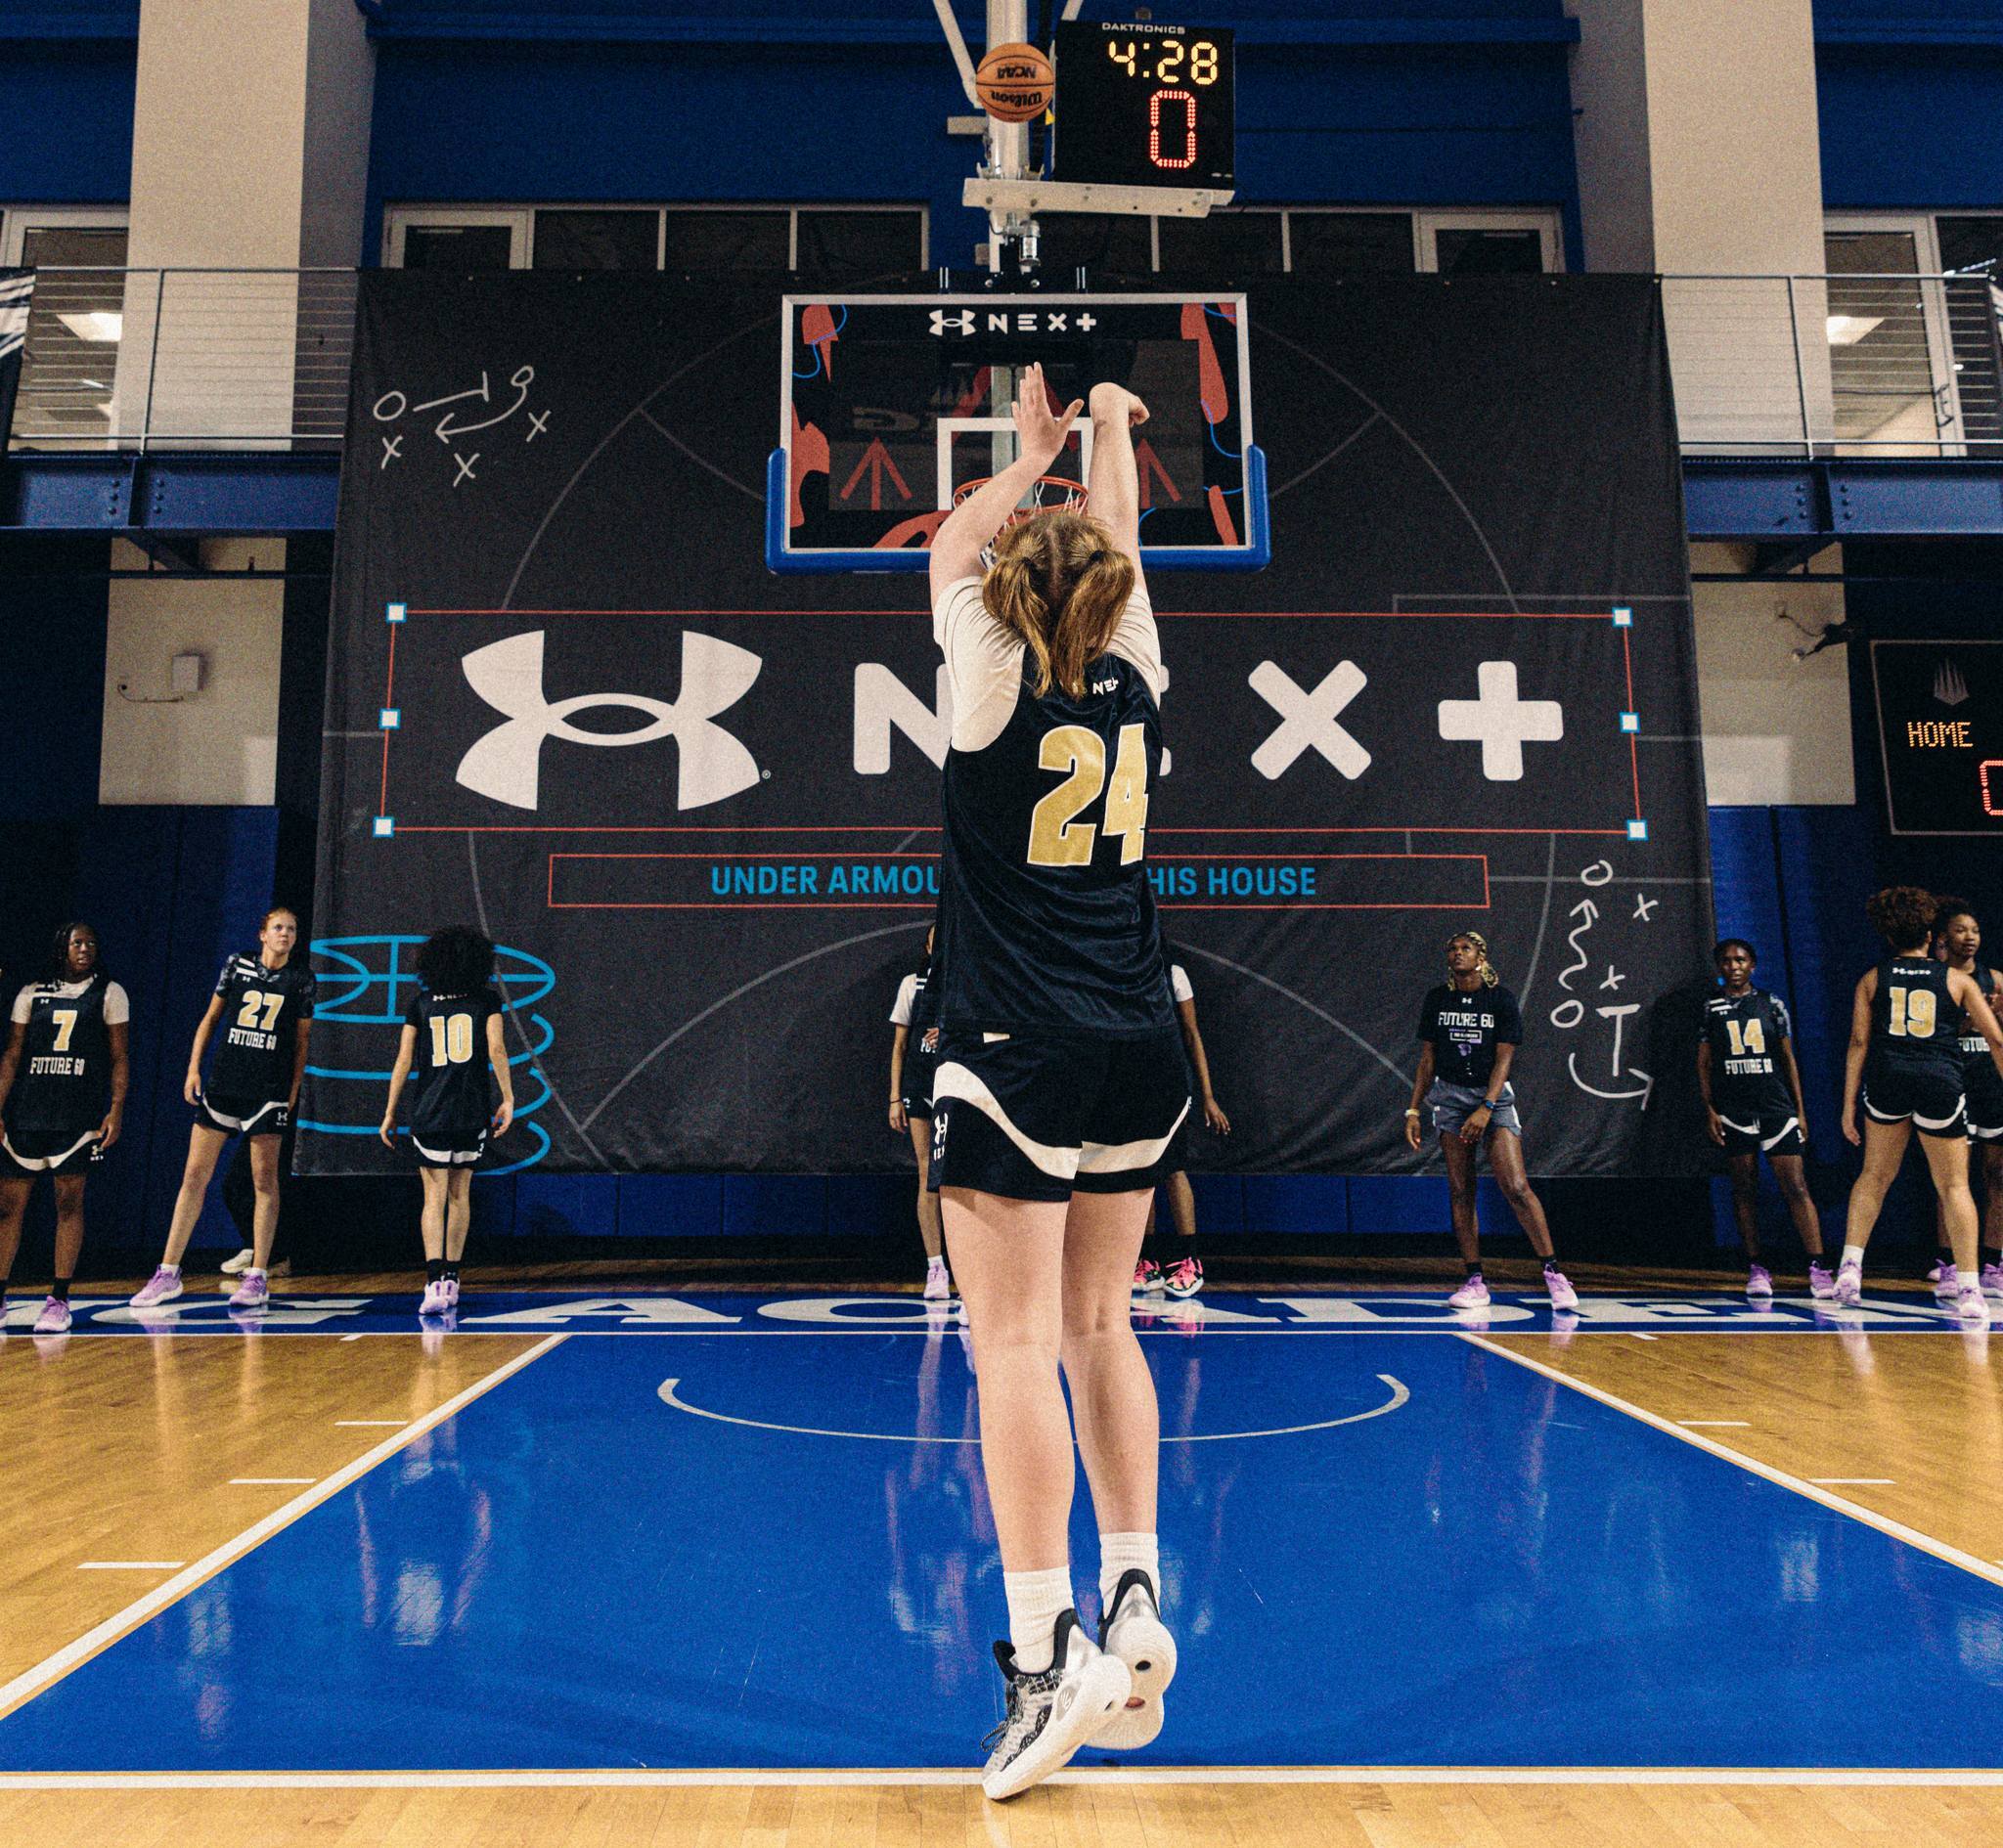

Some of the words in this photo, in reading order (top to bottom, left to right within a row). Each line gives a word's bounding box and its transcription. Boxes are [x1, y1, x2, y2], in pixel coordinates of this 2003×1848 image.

[1101, 22, 1186, 35] DAKTRONICS
[997, 65, 1036, 80] NCAA
[1108, 40, 1219, 86] 4:28
[991, 90, 1043, 108] Wilson
[1149, 89, 1196, 169] 0
[1907, 722, 1974, 747] HOME
[1027, 724, 1149, 867] 24
[711, 865, 819, 896] UNDER
[827, 864, 940, 896] ARMOU
[1146, 866, 1199, 897] HIS
[1208, 866, 1316, 897] HOUSE
[237, 990, 286, 1032] 27
[1439, 1011, 1478, 1027] FUTURE
[1888, 986, 1937, 1038] 19
[52, 1009, 78, 1052] 7
[227, 1028, 267, 1049] FUTURE
[428, 1013, 473, 1068] 10
[1725, 1018, 1765, 1055] 14
[29, 1057, 73, 1075] FUTURE
[1724, 1059, 1763, 1075] FUTURE
